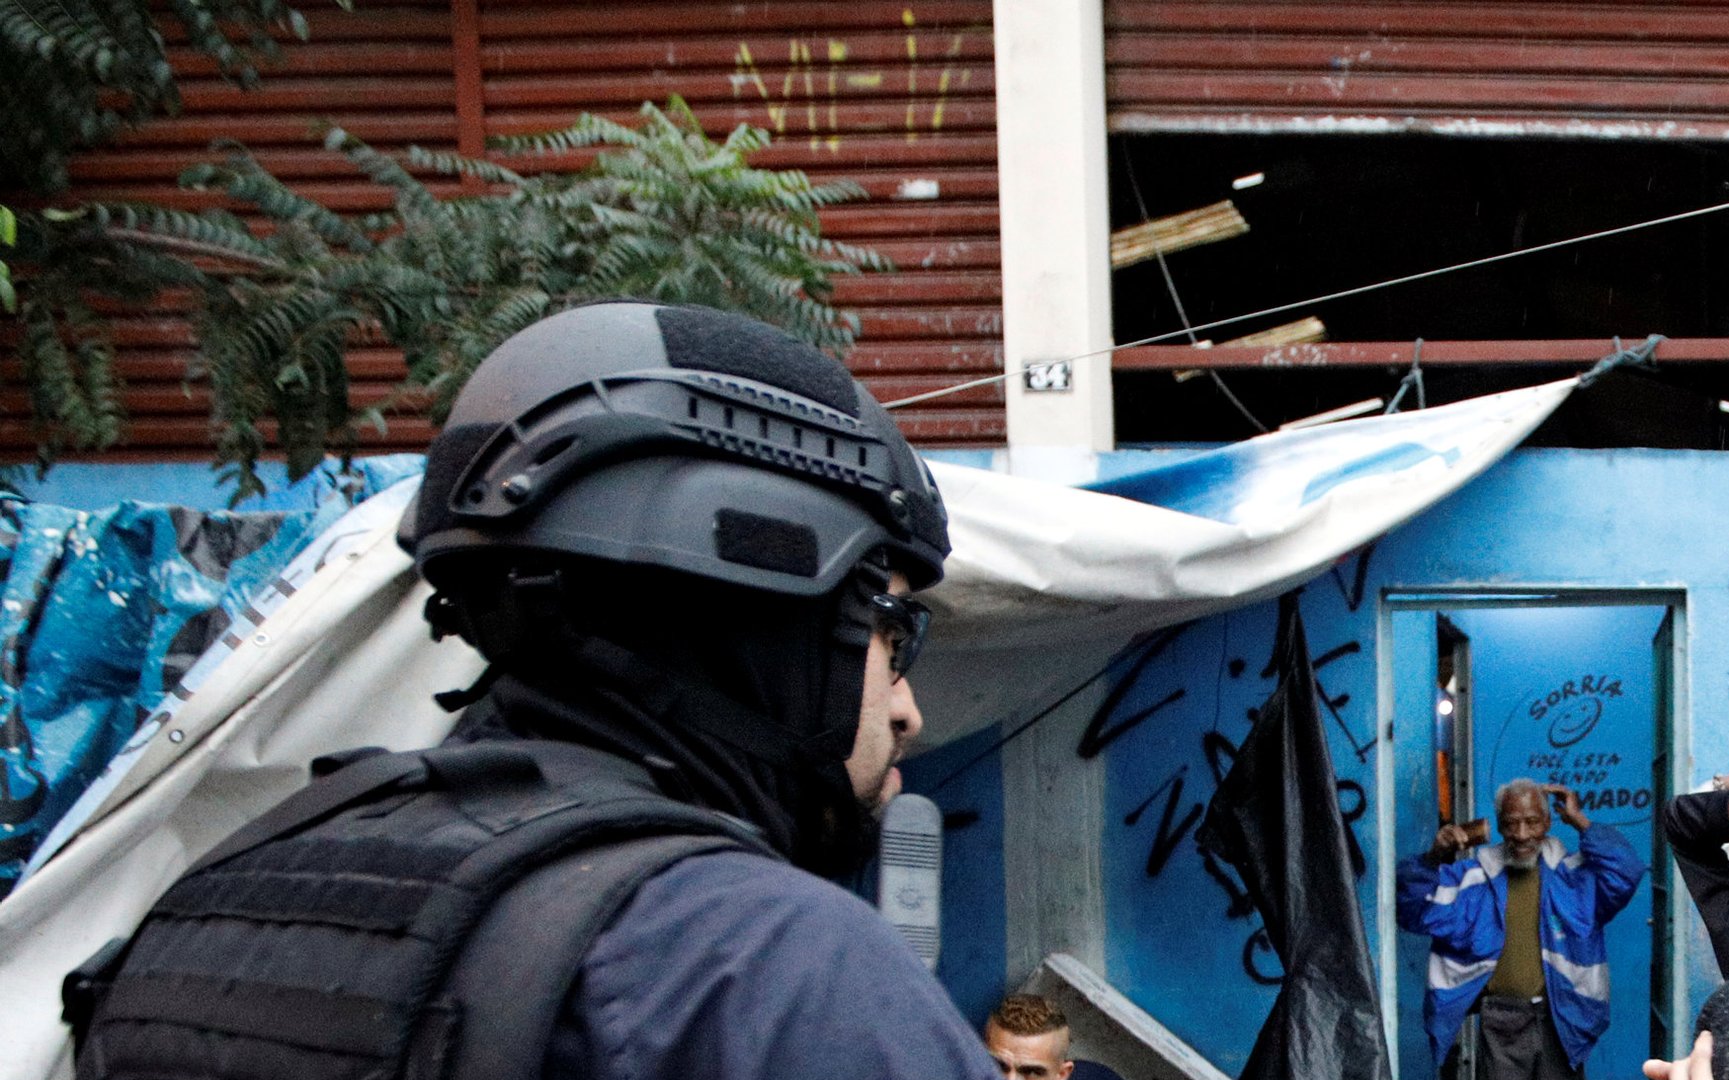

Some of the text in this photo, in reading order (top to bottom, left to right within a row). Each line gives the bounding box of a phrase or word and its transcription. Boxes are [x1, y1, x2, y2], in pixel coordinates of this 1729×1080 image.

[1029, 363, 1066, 390] 34
[1530, 674, 1623, 720] SORRIA
[1553, 788, 1651, 811] MADO
